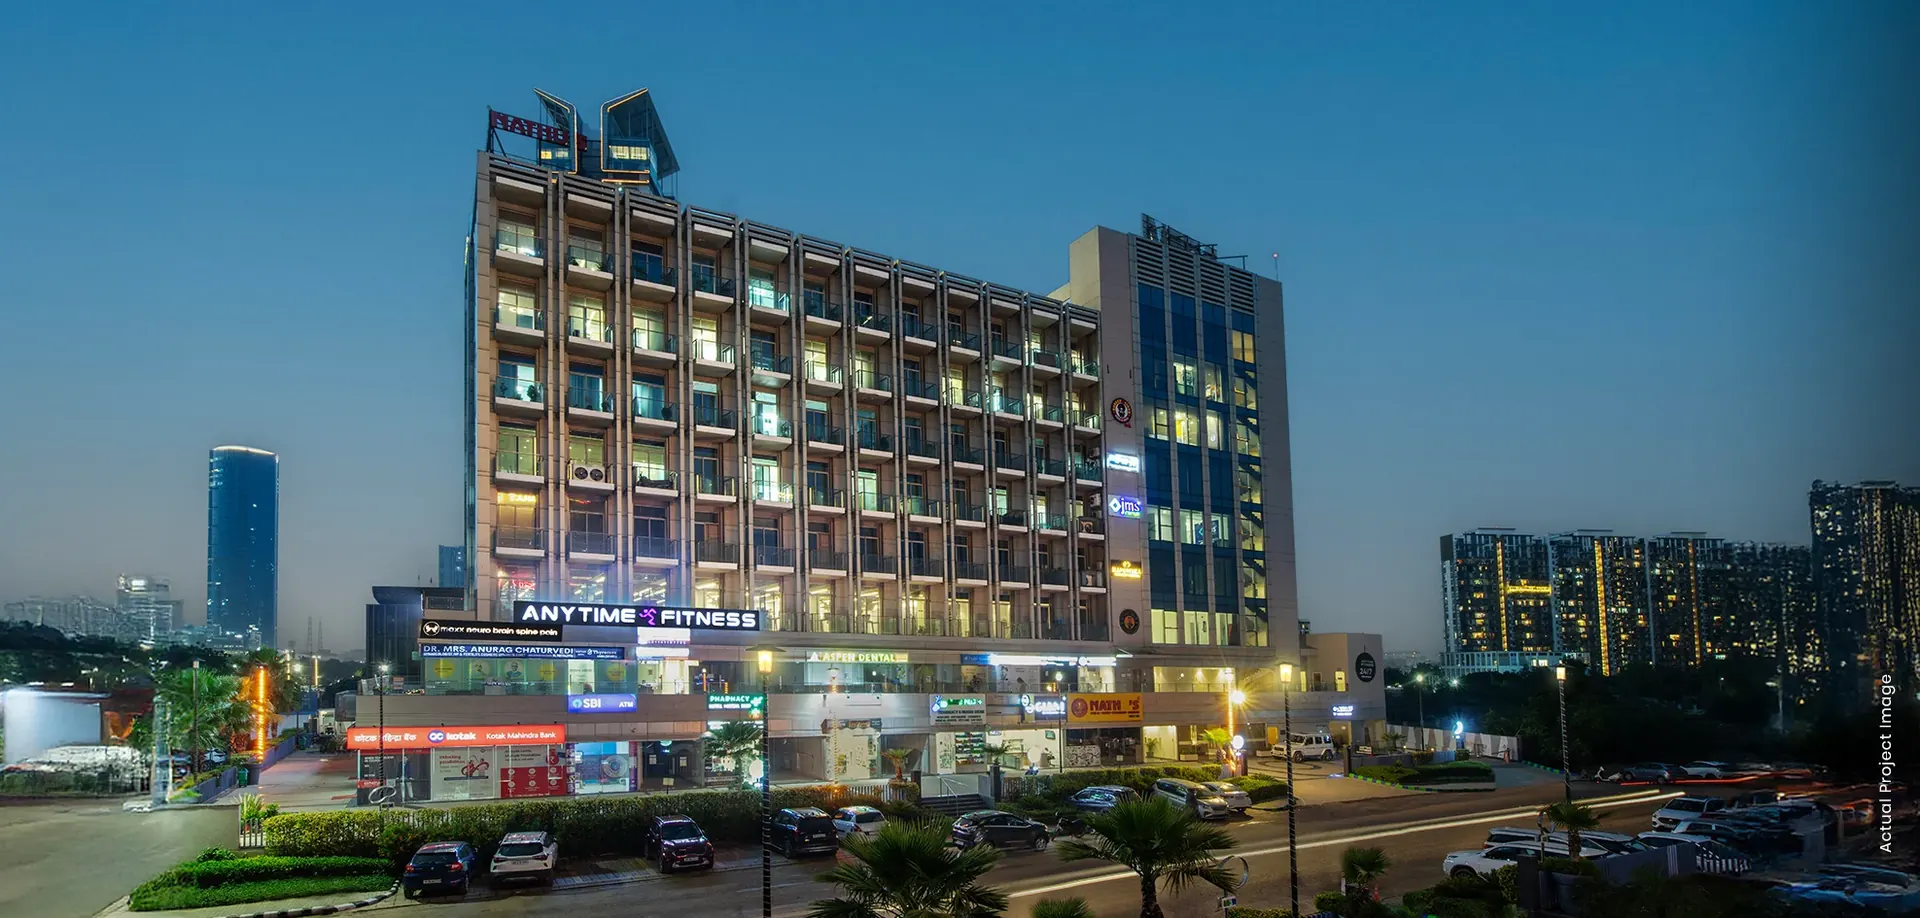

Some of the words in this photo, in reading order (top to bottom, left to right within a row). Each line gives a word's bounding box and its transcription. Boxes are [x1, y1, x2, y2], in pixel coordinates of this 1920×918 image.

[1121, 498, 1140, 515] jms
[522, 604, 636, 623] ANYTIME
[661, 609, 756, 628] FITNESS
[466, 626, 491, 634] neuro
[492, 627, 514, 635] brain
[515, 627, 539, 636] spine
[539, 628, 558, 636] pain
[423, 645, 440, 653] DR.
[443, 645, 468, 653] MRS.
[471, 646, 513, 654] ANURAG
[515, 646, 574, 655] CHATURVEDI
[859, 652, 895, 662] DENTAL
[583, 698, 602, 708] SBI
[446, 732, 477, 741] kotak
[486, 732, 506, 740] Kotak
[507, 732, 539, 740] Mahindra
[540, 731, 556, 739] Bank
